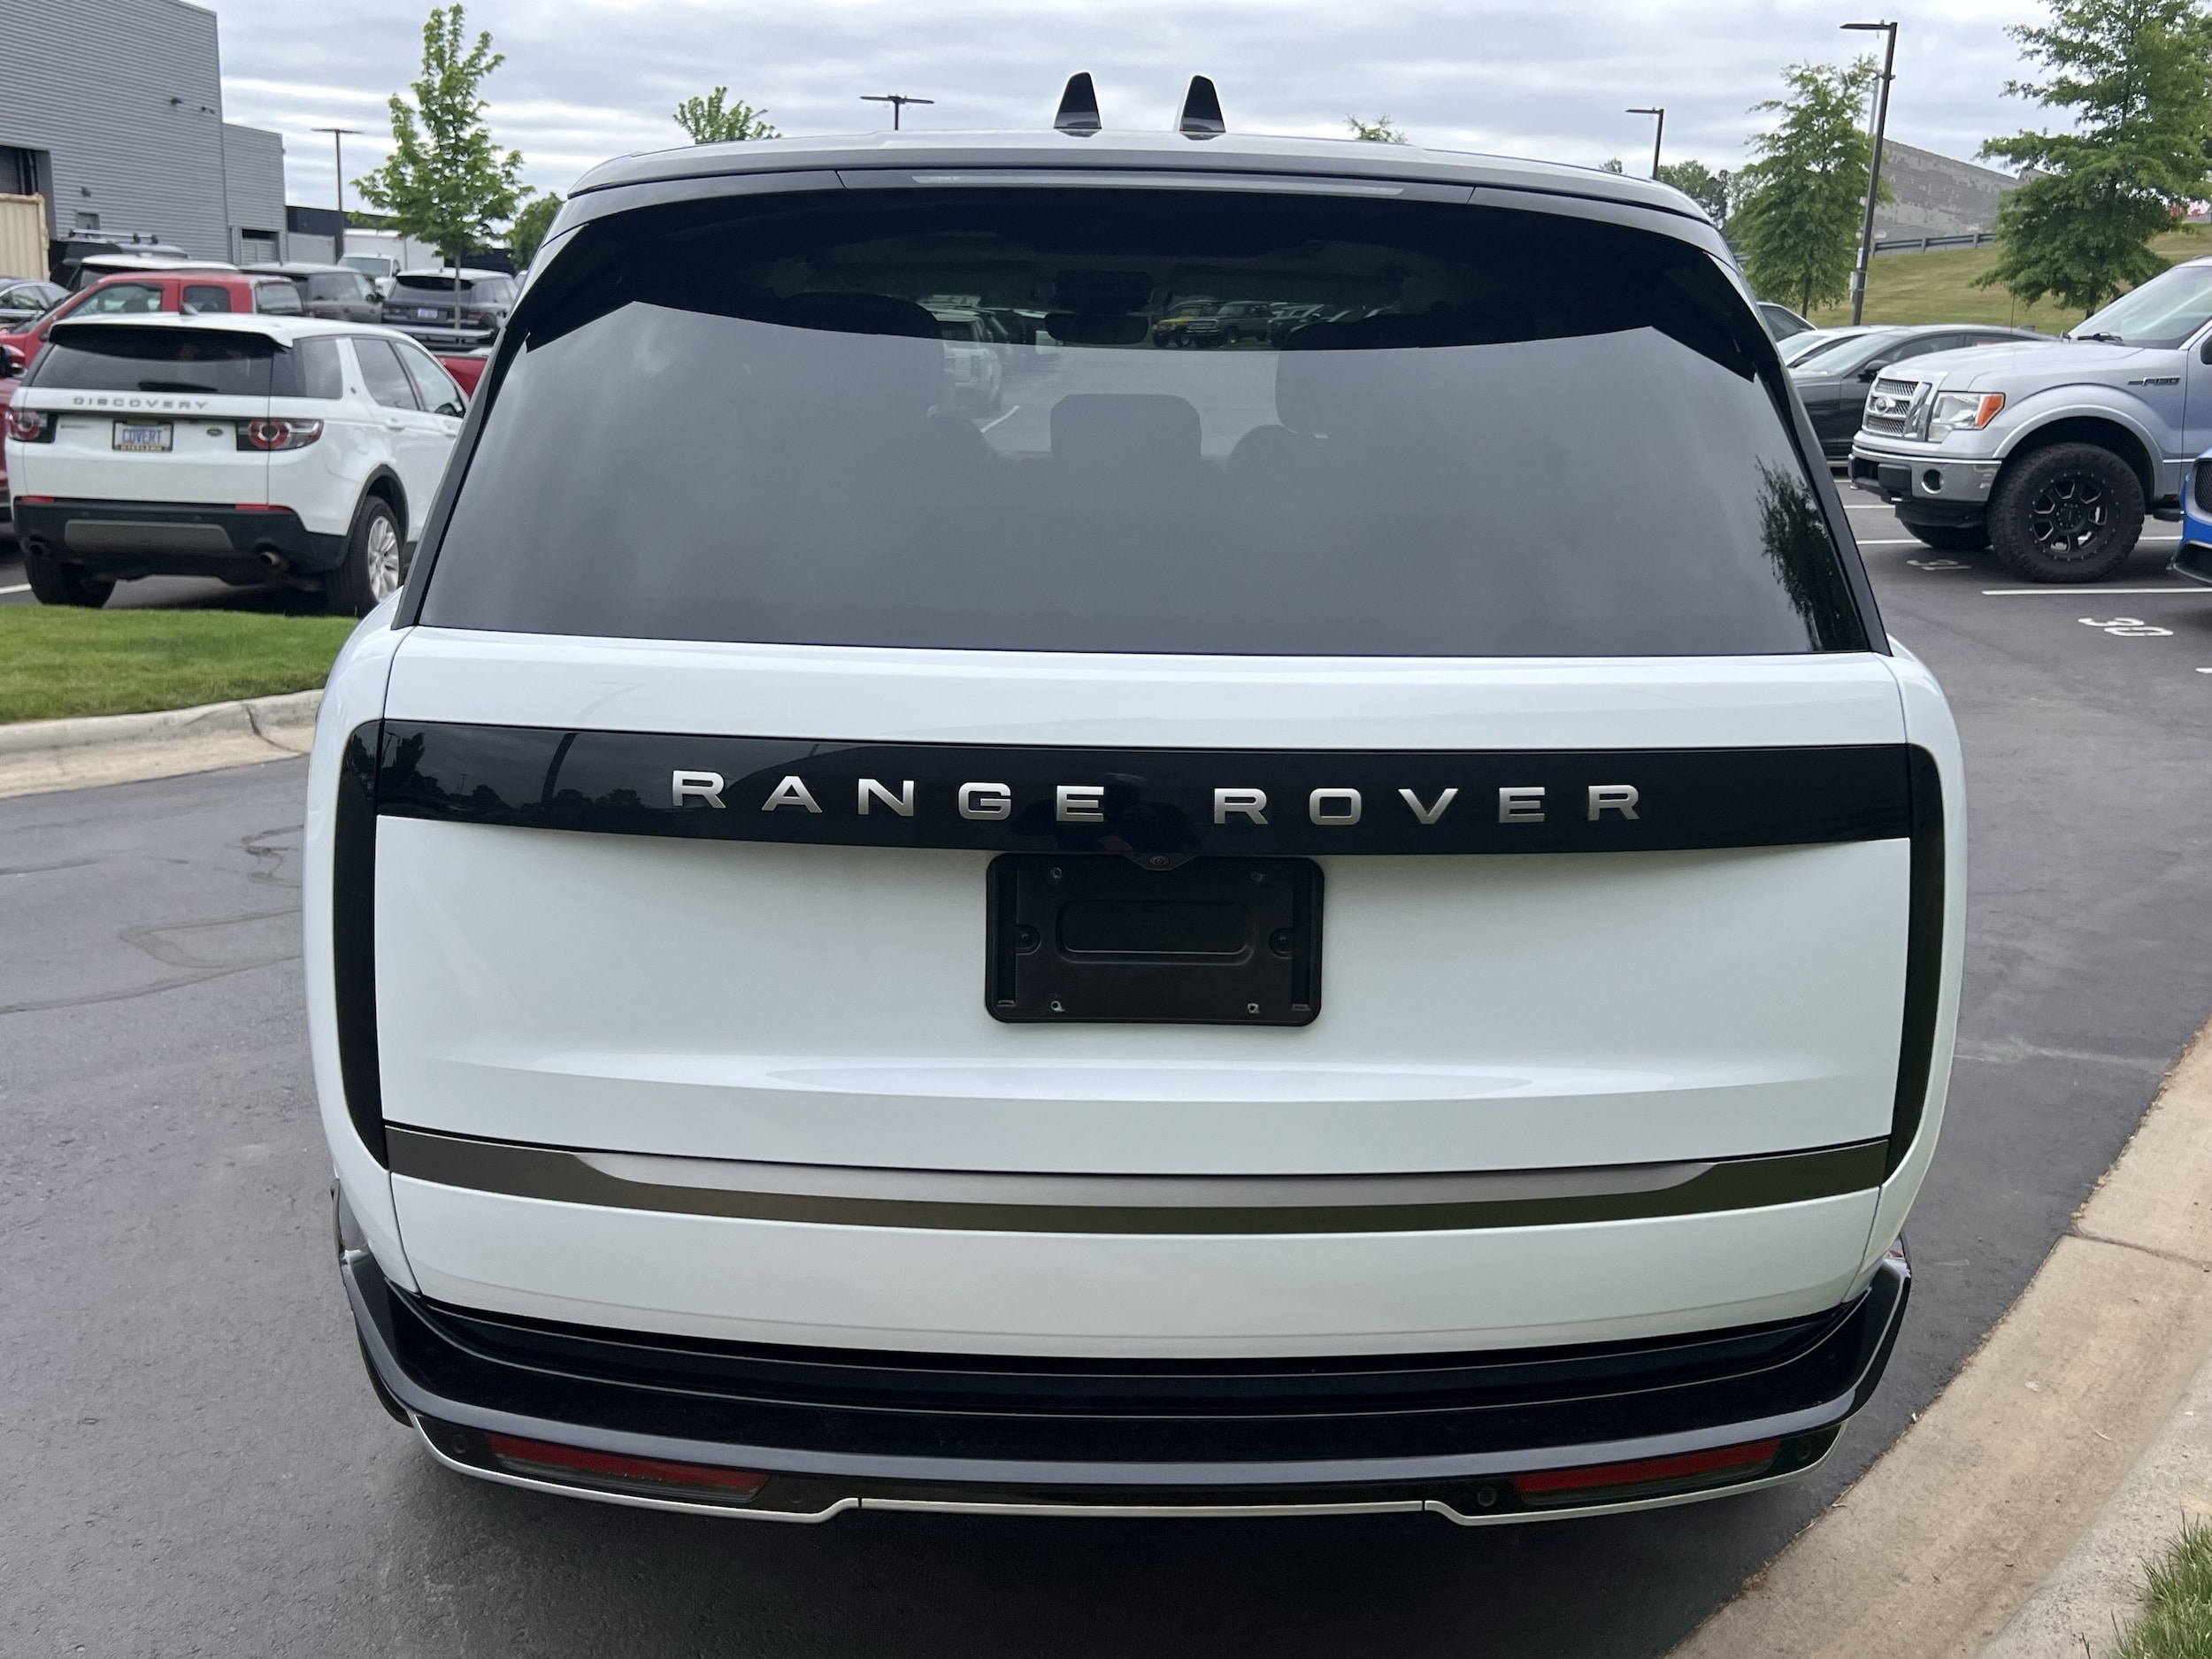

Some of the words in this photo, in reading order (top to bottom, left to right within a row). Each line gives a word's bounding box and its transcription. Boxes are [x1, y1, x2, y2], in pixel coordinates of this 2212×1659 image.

[73, 397, 207, 410] DISCOVERY
[122, 428, 163, 444] COVERT
[2078, 617, 2174, 637] 30
[671, 769, 1105, 823] RANGE
[1213, 784, 1640, 826] ROVER
